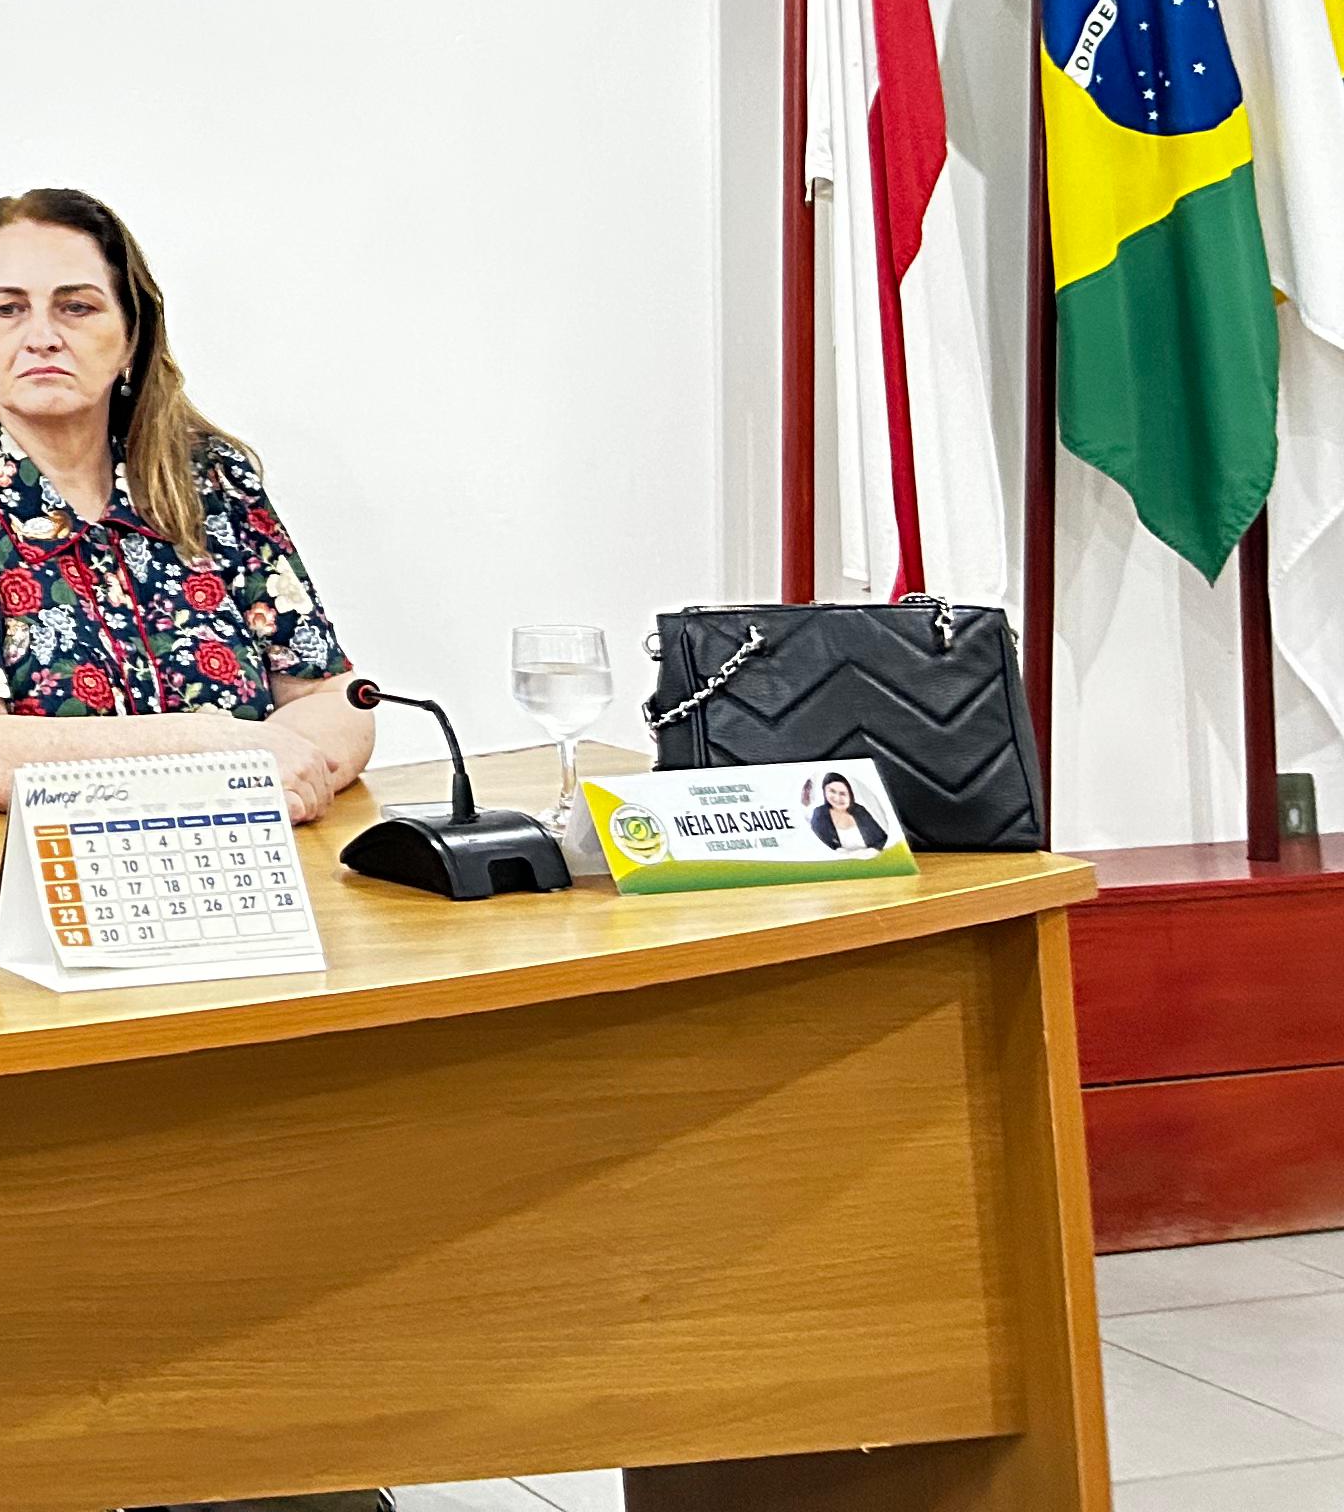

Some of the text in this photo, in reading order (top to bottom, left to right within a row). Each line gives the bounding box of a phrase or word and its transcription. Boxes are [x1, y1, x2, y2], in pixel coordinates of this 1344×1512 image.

[227, 775, 274, 790] CAIXA
[673, 810, 716, 837] NÉIA
[714, 812, 741, 834] DA
[739, 805, 796, 833] SAÚDE
[86, 840, 96, 853] 2
[121, 838, 131, 851] 3
[159, 835, 168, 848] 4
[194, 833, 202, 846] 5
[229, 830, 238, 843] 6
[263, 828, 271, 841] 7
[90, 862, 99, 875] 9
[122, 860, 139, 873] 10
[160, 858, 174, 871] 11
[194, 855, 211, 868] 12
[229, 852, 246, 865] 13
[264, 850, 281, 863] 14
[54, 872, 287, 901] 15 16 17 18 19 20 21
[58, 893, 294, 924] 22 23 24 25 26 27 28
[100, 929, 119, 942] 30
[138, 926, 155, 940] 31
